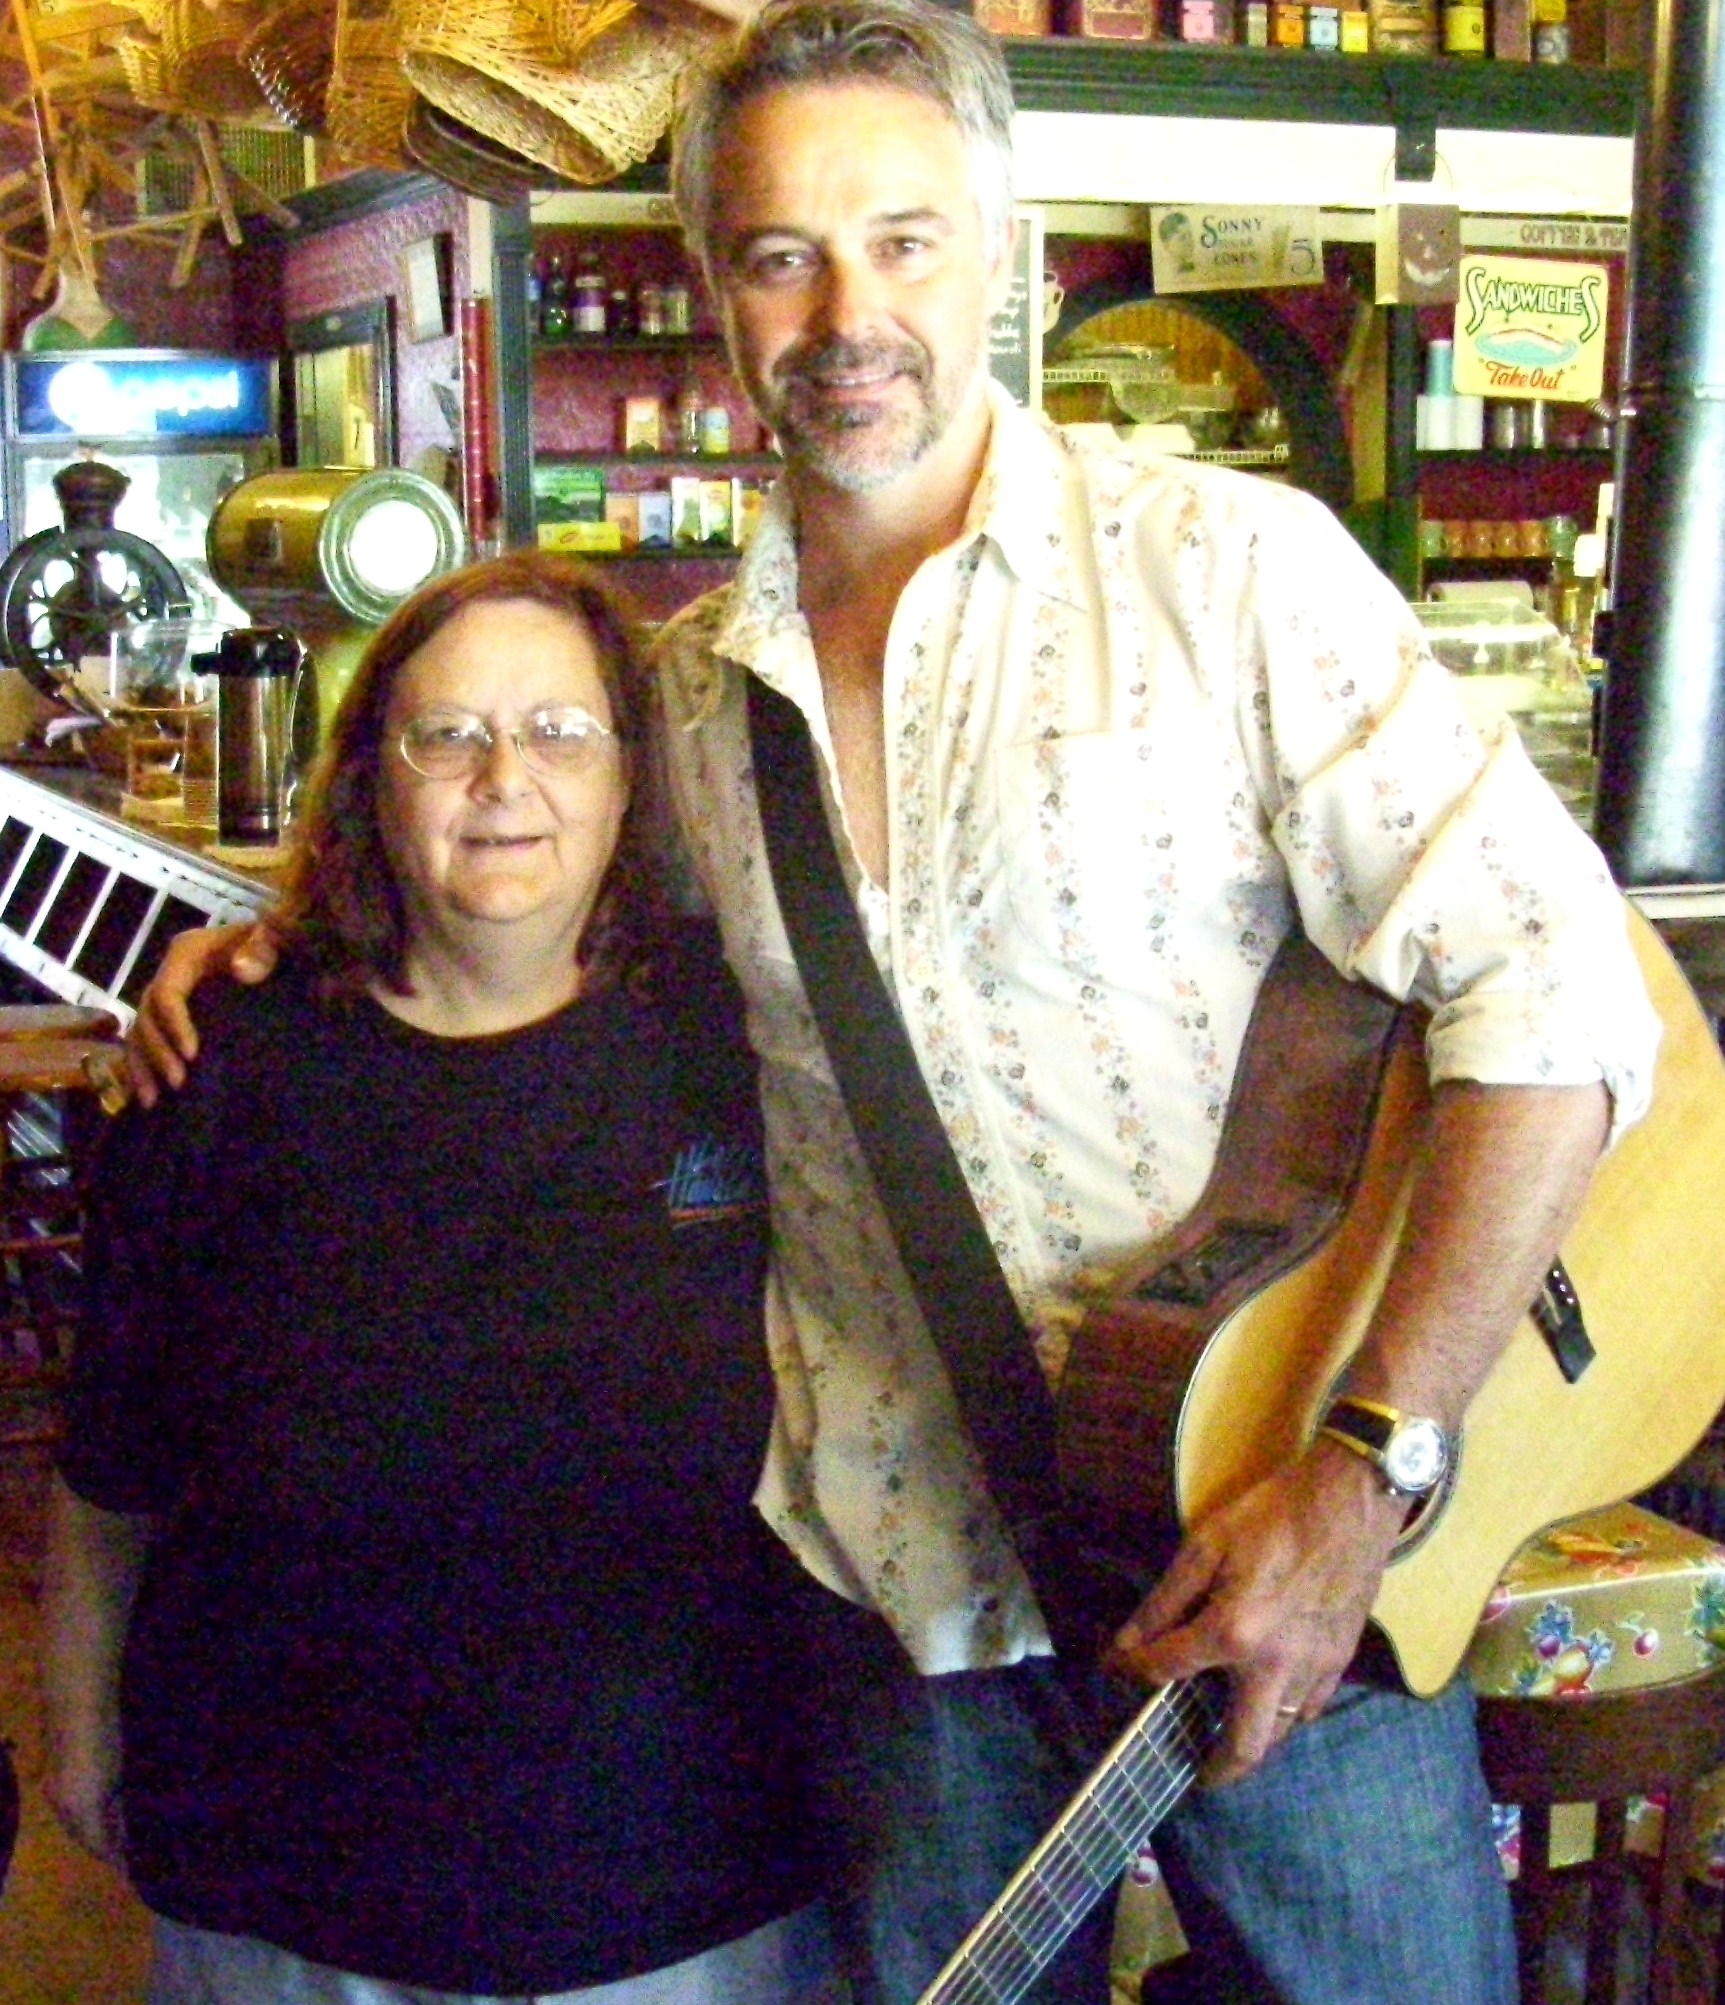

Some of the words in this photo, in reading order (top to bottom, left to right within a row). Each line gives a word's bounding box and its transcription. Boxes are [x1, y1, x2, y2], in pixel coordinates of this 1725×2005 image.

[1200, 213, 1264, 249] SONNY
[1291, 238, 1316, 276] 5
[1464, 266, 1602, 345] SANDWICHES
